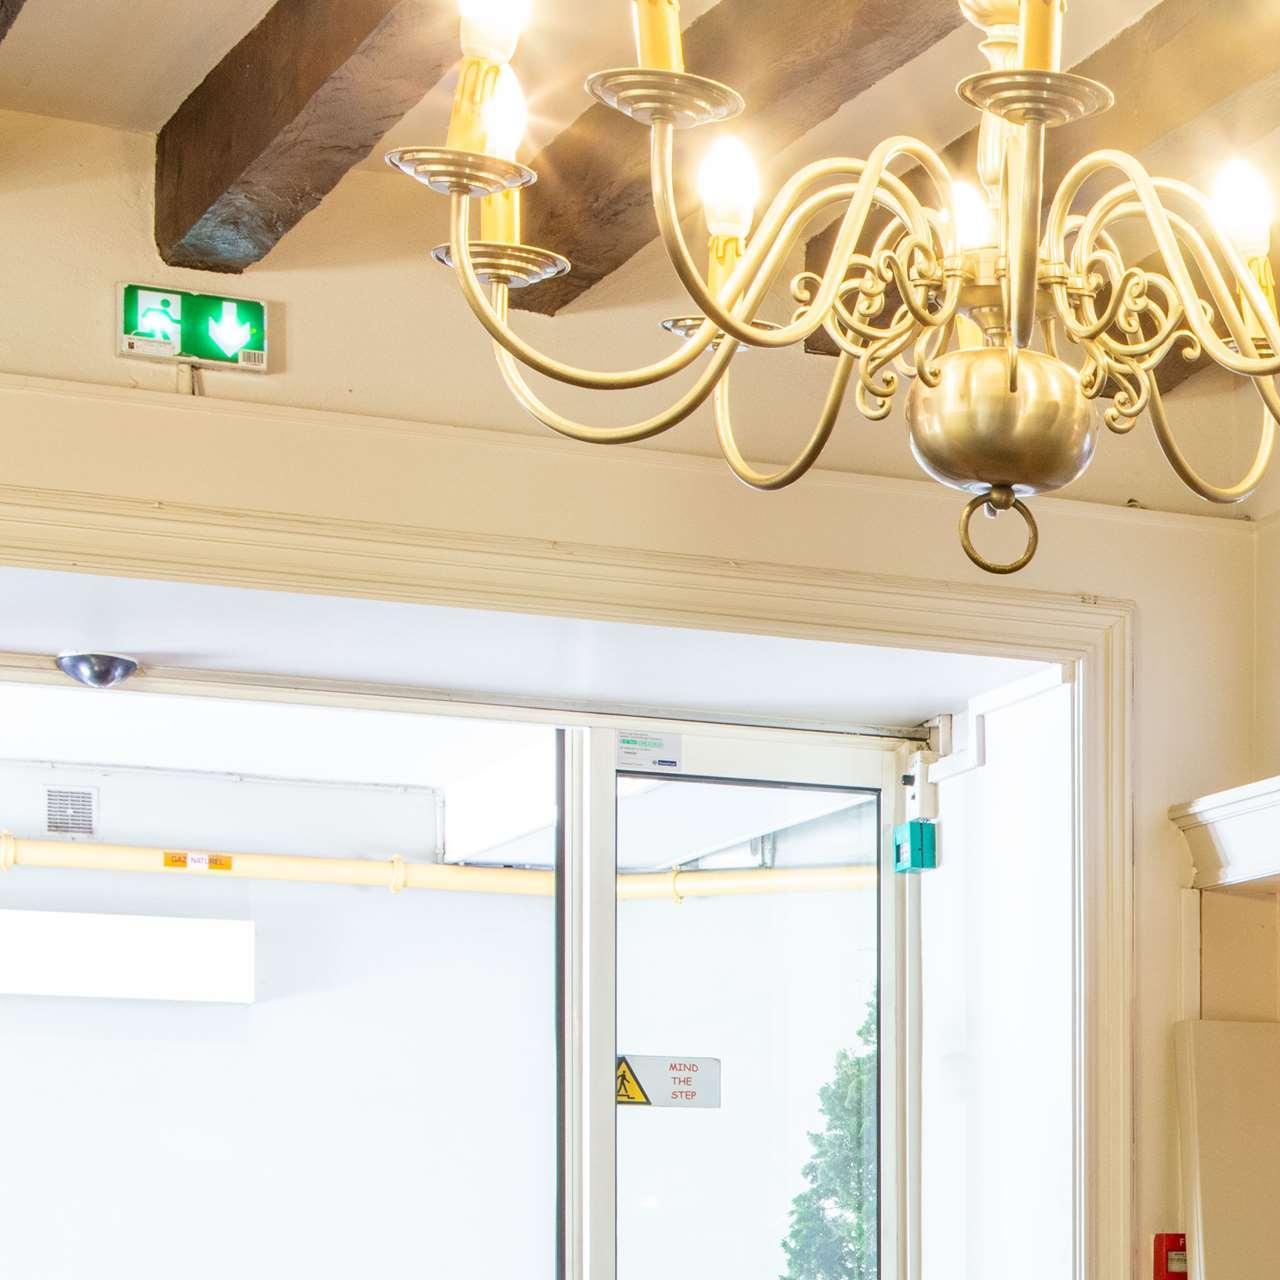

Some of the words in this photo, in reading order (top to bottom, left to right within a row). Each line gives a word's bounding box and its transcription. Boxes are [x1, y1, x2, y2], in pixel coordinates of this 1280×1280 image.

[668, 1063, 699, 1073] MIND
[671, 1076, 693, 1086] THE
[671, 1090, 697, 1100] STEP
